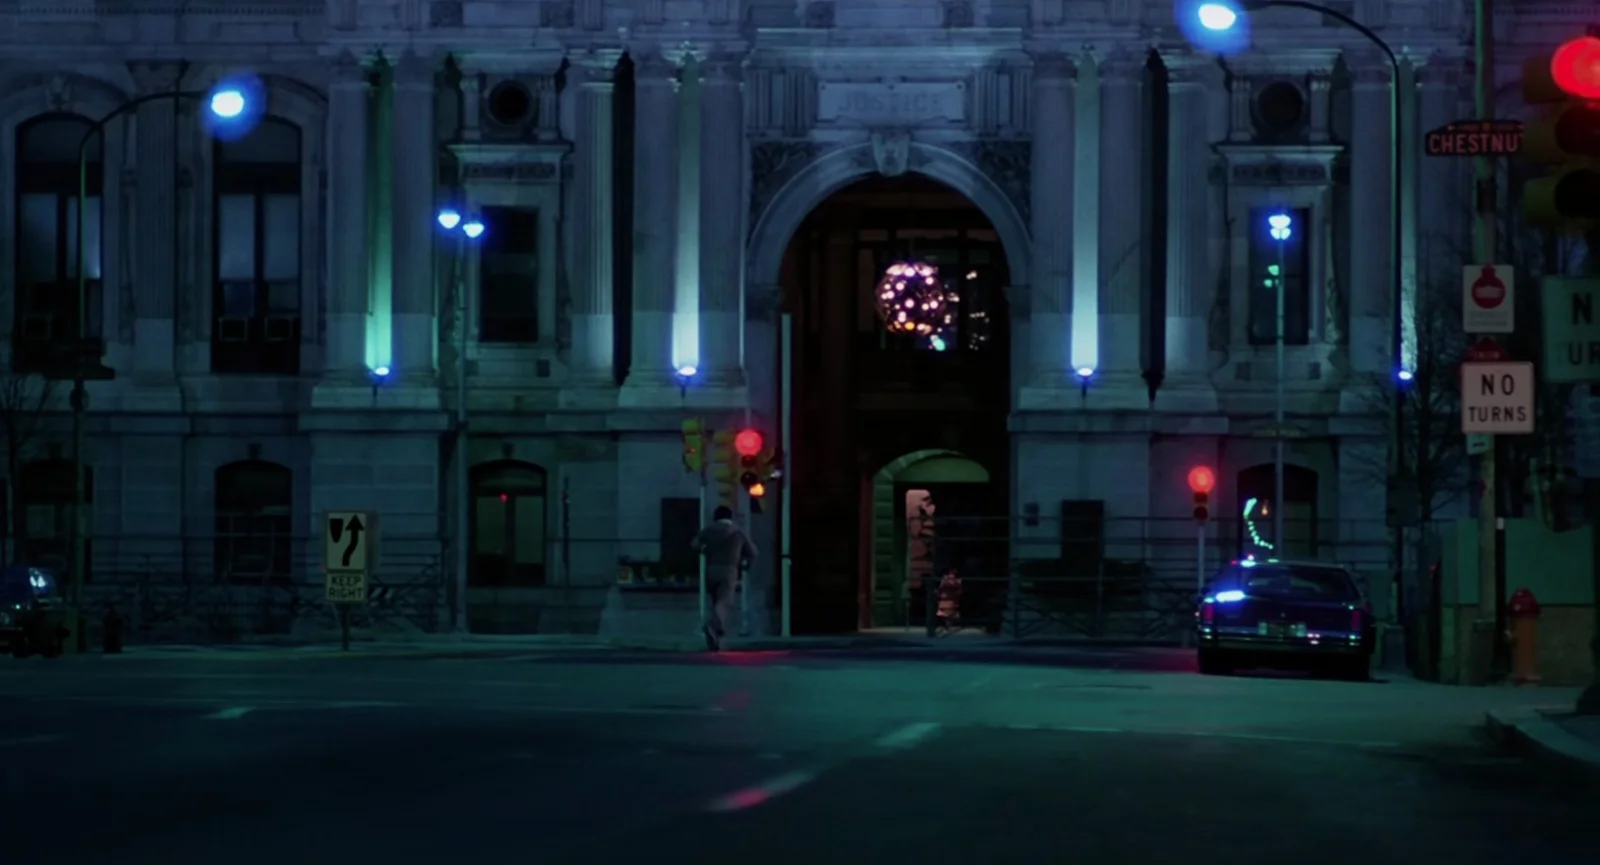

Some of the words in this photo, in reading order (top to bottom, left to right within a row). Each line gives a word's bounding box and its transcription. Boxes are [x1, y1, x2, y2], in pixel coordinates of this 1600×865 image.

[1429, 133, 1524, 153] CHESTNU
[1481, 374, 1515, 396] NO
[1468, 406, 1526, 422] TURNS
[331, 575, 361, 586] KEEP
[329, 587, 362, 599] RIGHT
